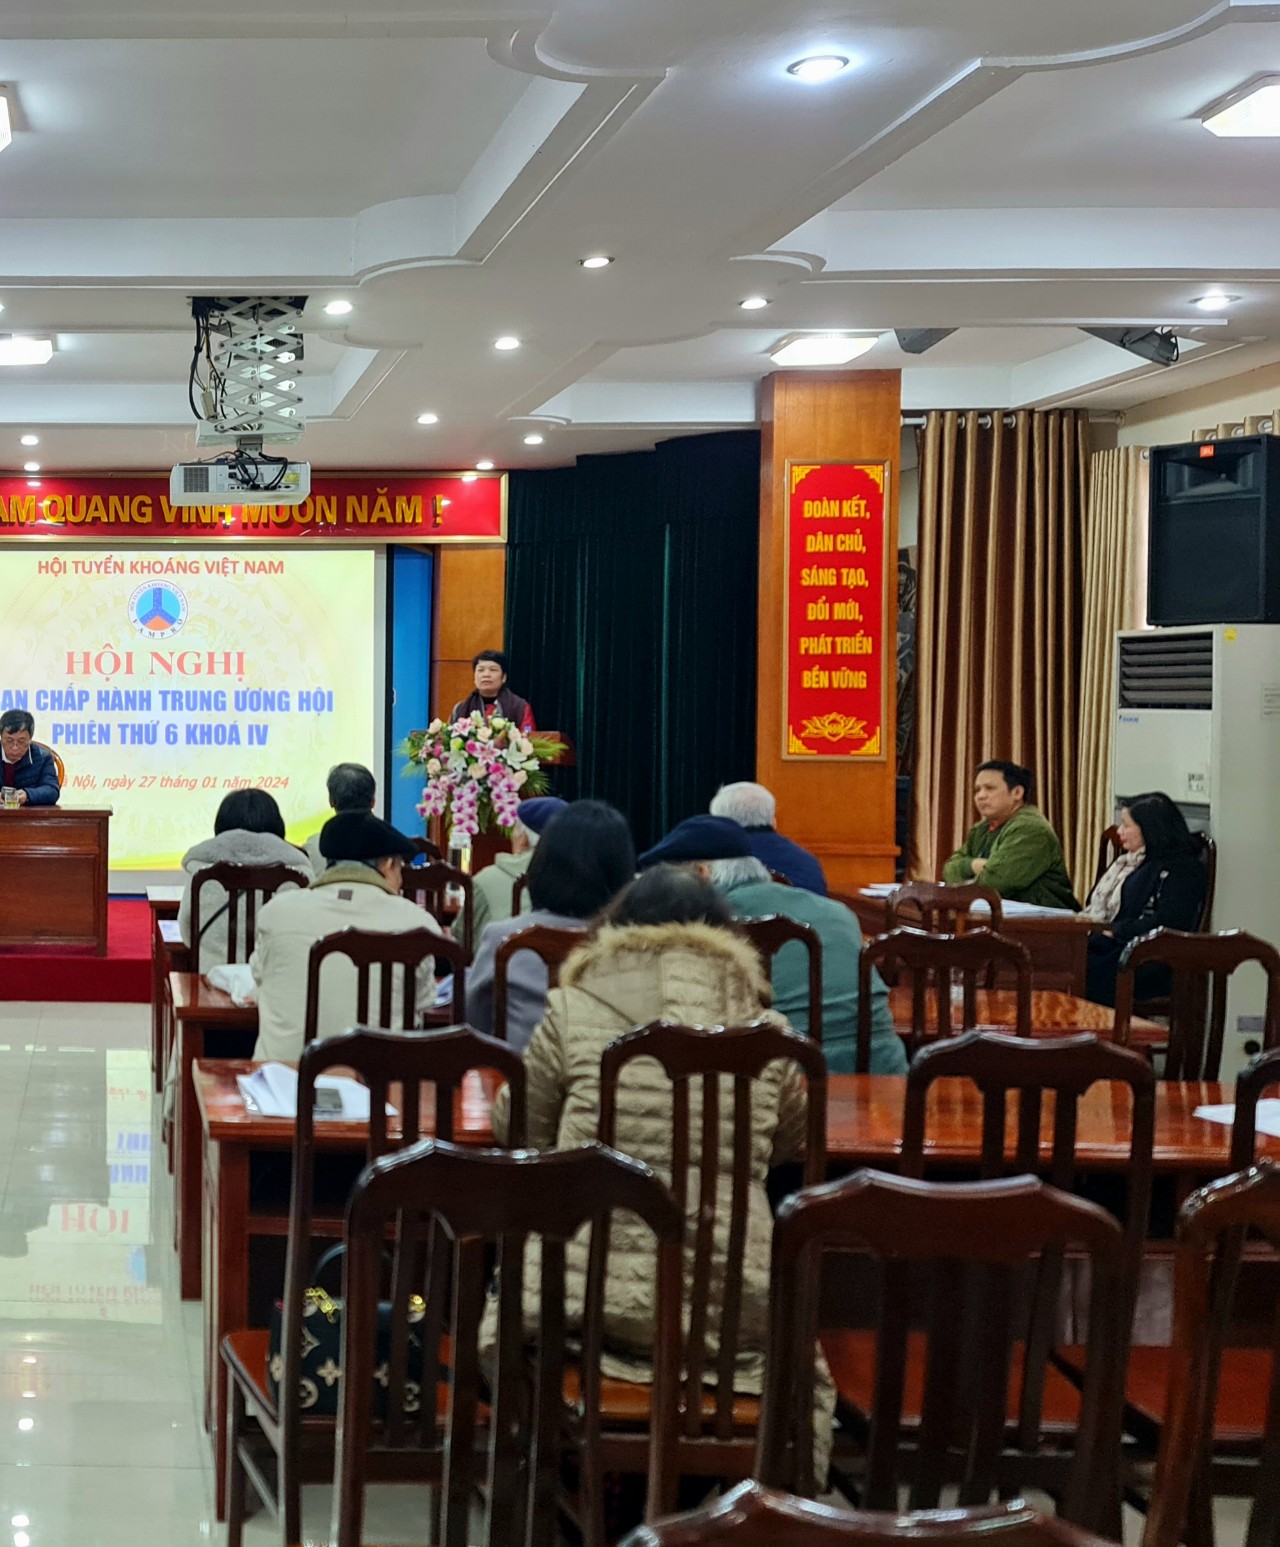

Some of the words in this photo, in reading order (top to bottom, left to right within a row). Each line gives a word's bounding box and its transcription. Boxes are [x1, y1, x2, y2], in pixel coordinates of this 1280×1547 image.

[43, 494, 152, 524] QUANG
[346, 487, 422, 524] NĂM
[804, 499, 839, 518] ĐOÀN
[842, 494, 869, 519] KẾT,
[806, 532, 833, 552] DÂN
[836, 528, 866, 554] CHỦ,
[38, 558, 67, 577] HỘI
[72, 555, 124, 574] TUYỂN
[130, 557, 200, 574] KHOÁNG
[205, 558, 240, 577] VIỆT
[245, 561, 284, 574] NAM
[801, 565, 836, 586] SÁNG
[841, 568, 868, 589] TẠO,
[807, 595, 829, 620] ĐỔI
[834, 599, 863, 622] MỚI,
[800, 635, 833, 654] PHÁT
[835, 630, 872, 655] TRIỂN
[66, 643, 134, 682] HỘI
[150, 651, 244, 682] NGHỊ
[832, 667, 867, 689] VỮNG
[35, 683, 89, 711] CHẤP
[97, 683, 151, 711] HÀNH
[159, 690, 227, 711] TRUNG
[234, 687, 290, 712] ƯƠNG
[298, 686, 333, 716] HỘI
[52, 718, 111, 745] PHIÊN
[117, 719, 159, 745] THỨ
[165, 724, 178, 745] 6
[185, 720, 240, 745] KHOÁ
[248, 724, 269, 745] IV
[73, 775, 97, 790] Nội,
[103, 775, 134, 790] ngày
[139, 776, 156, 787] 27
[160, 775, 197, 790] tháng
[202, 777, 217, 788] 01
[223, 776, 251, 788] năm
[256, 777, 288, 788] 2024
